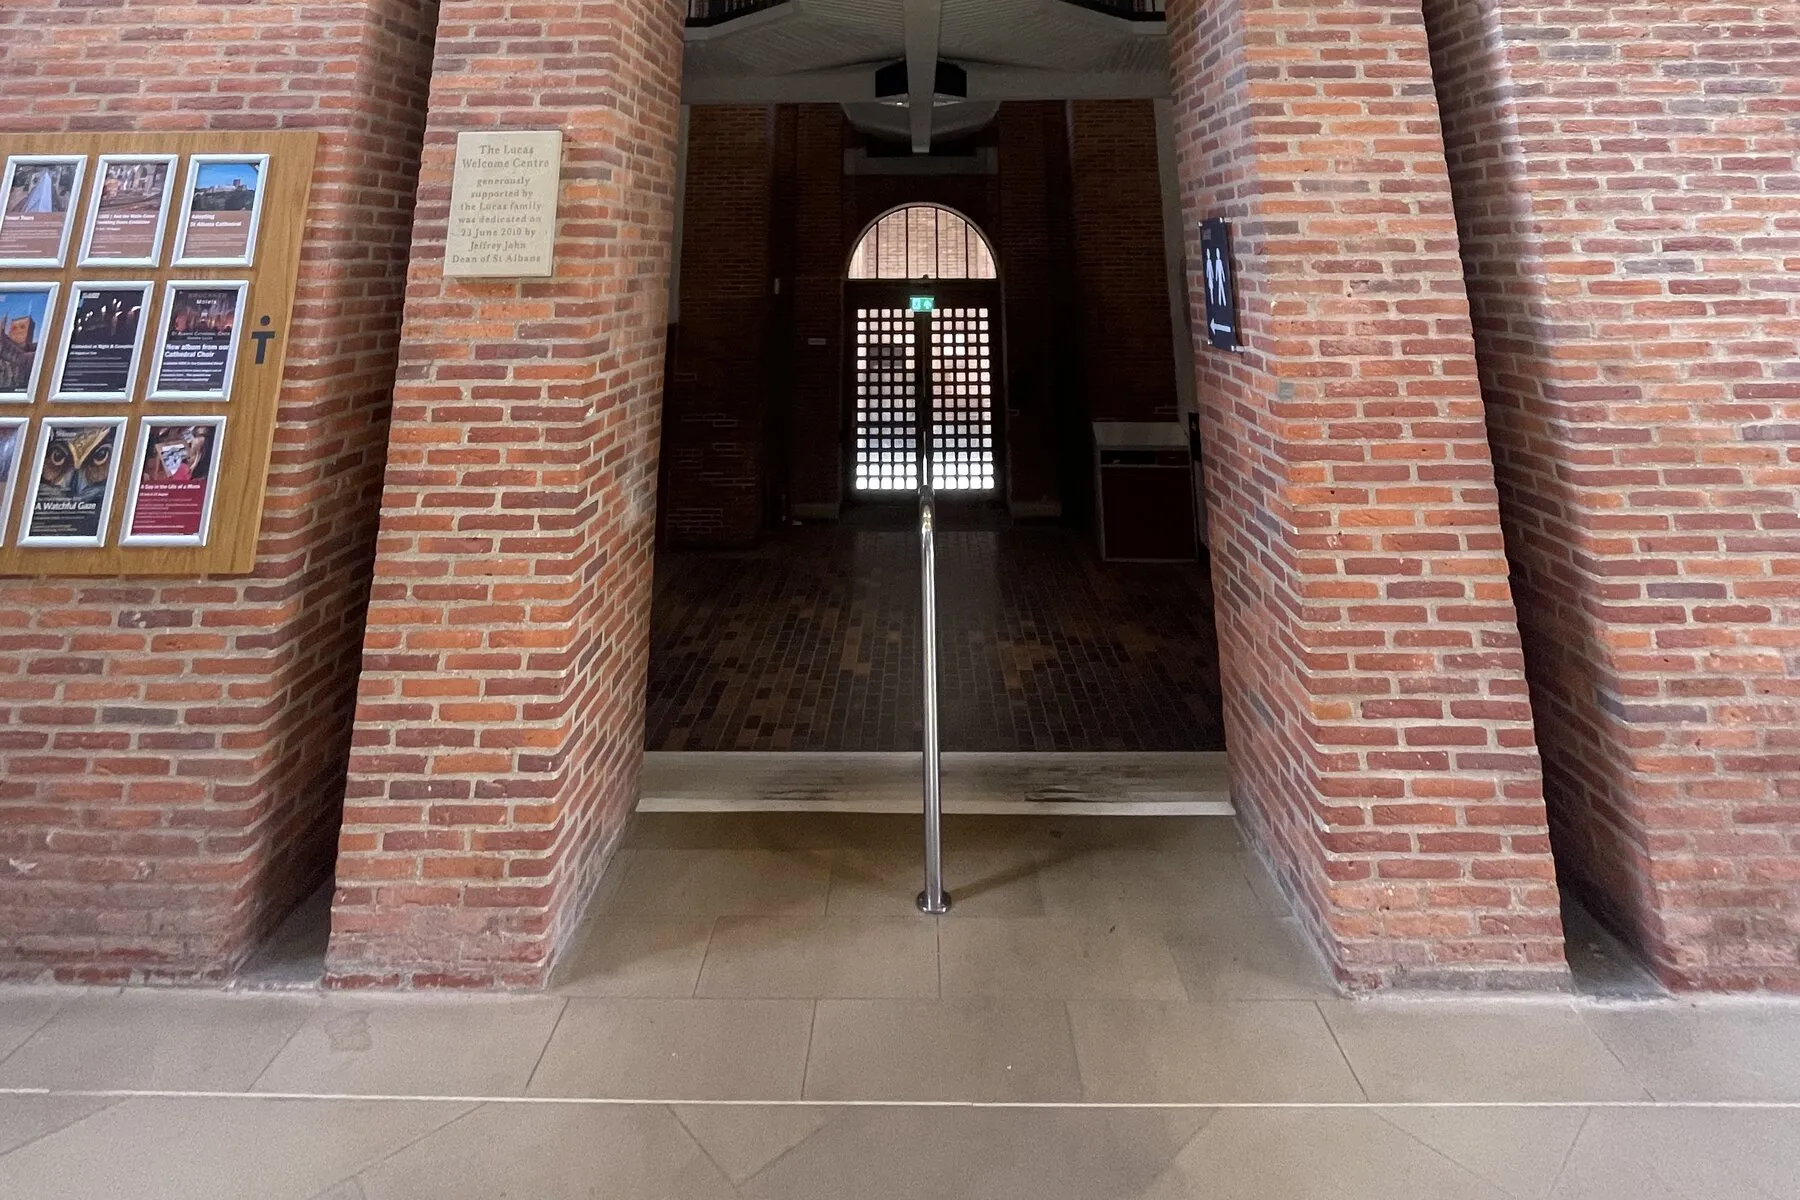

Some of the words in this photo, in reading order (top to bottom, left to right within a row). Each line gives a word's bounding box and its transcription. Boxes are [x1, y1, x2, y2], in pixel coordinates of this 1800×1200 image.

[478, 144, 501, 154] The
[503, 144, 534, 154] Lucas
[462, 158, 509, 169] Welcome
[512, 157, 550, 168] Centre
[476, 177, 531, 188] generously
[470, 189, 520, 201] supported
[521, 189, 534, 199] by
[460, 203, 477, 211] the
[479, 203, 507, 211] Lucas
[510, 201, 542, 212] family
[458, 216, 476, 224] was
[479, 215, 527, 224] dedicated
[474, 228, 498, 238] June
[524, 227, 537, 237] by
[468, 241, 502, 252] Jeffrey
[502, 241, 526, 252] John
[452, 255, 477, 264] Dean
[480, 254, 490, 263] of
[493, 255, 502, 263] St
[507, 254, 541, 263] Albans
[180, 343, 201, 351] album
[34, 502, 42, 510] A
[43, 502, 77, 510] Watchful
[78, 501, 97, 510] Gaze
